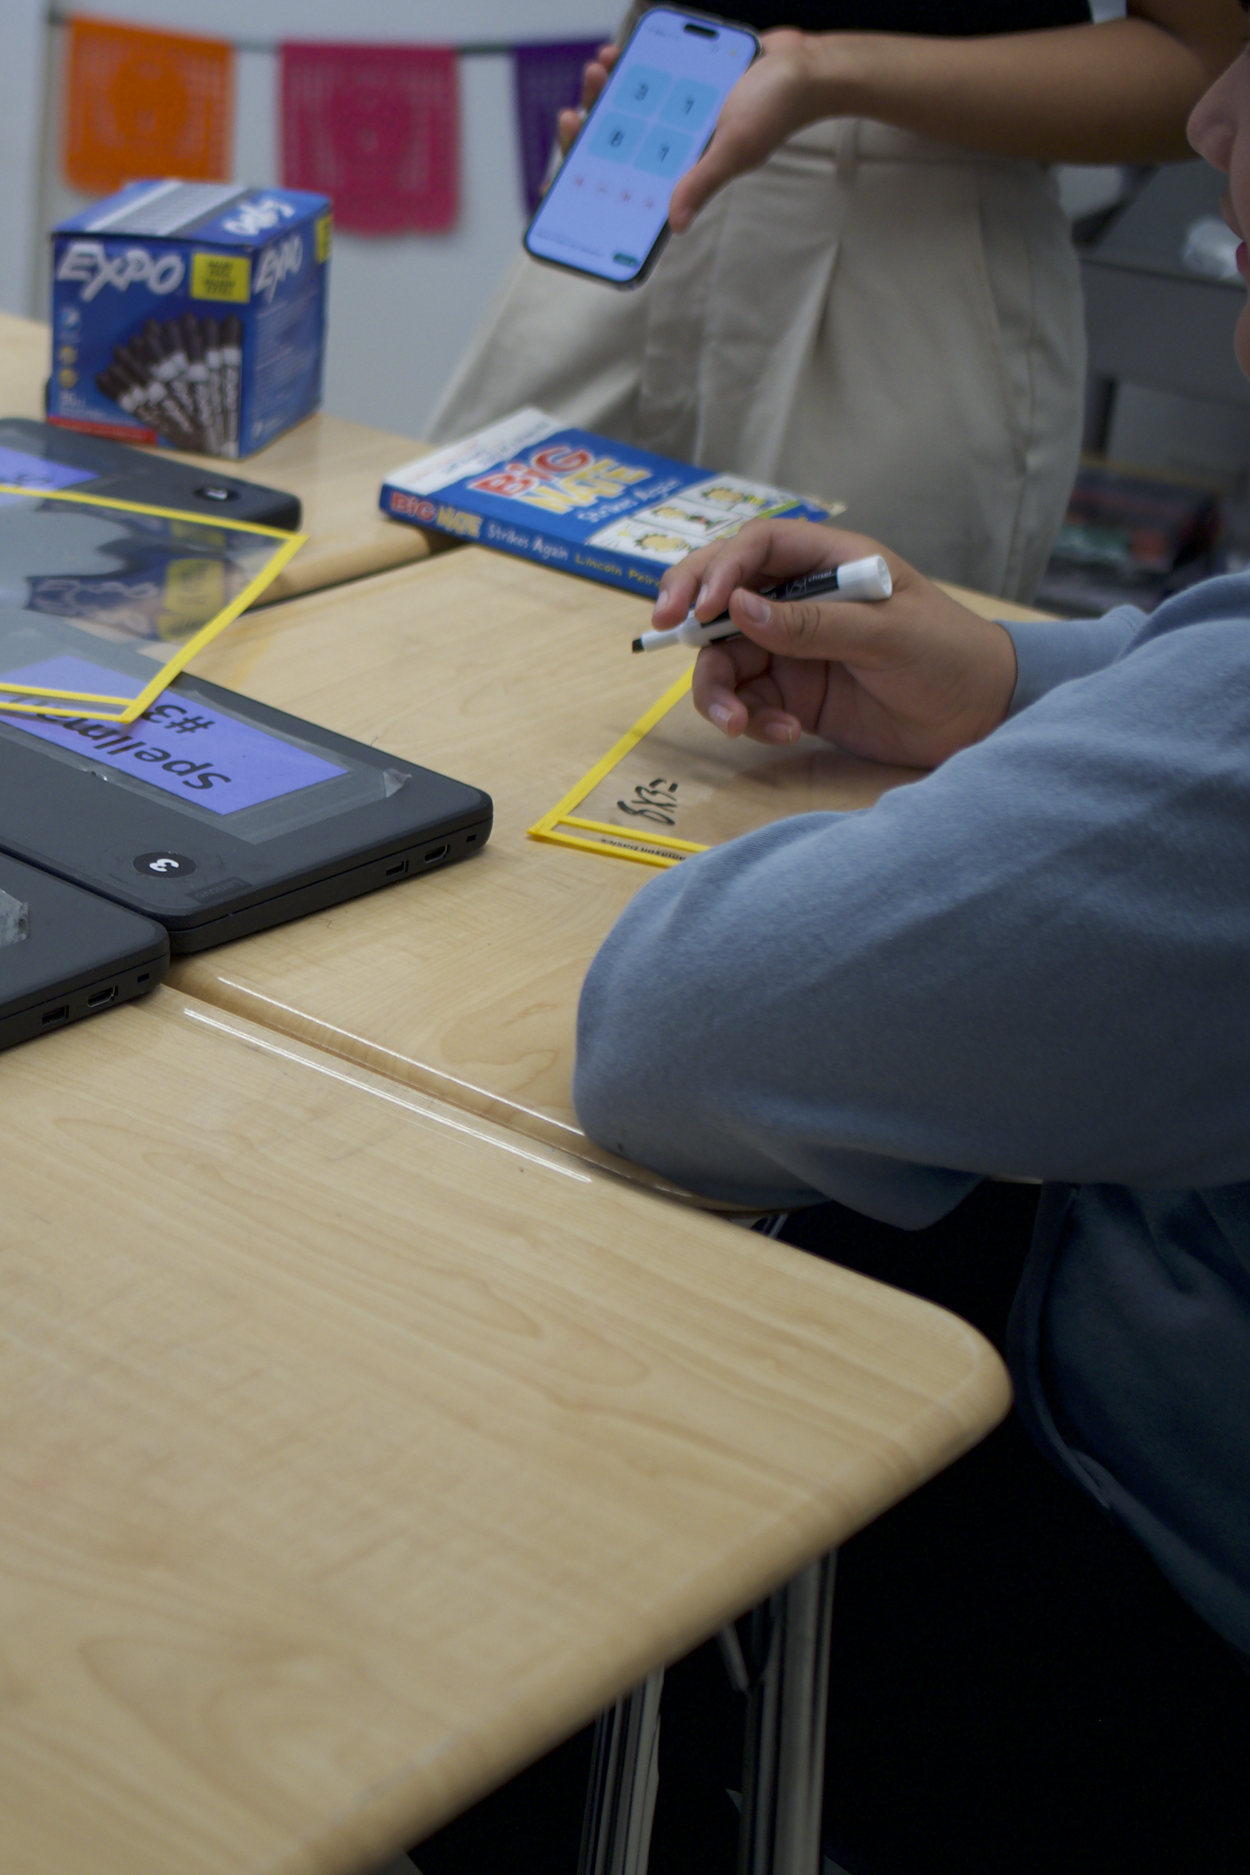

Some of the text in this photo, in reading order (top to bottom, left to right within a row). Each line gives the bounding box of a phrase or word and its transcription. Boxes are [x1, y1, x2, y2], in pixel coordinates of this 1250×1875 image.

[57, 242, 185, 303] EXPO
[254, 236, 304, 304] EXPO
[436, 504, 484, 539] NATE
[487, 521, 530, 550] Strikes
[532, 535, 570, 561] Again
[575, 552, 623, 578] Lincoln
[141, 704, 216, 734] #3
[149, 858, 180, 874] 3
